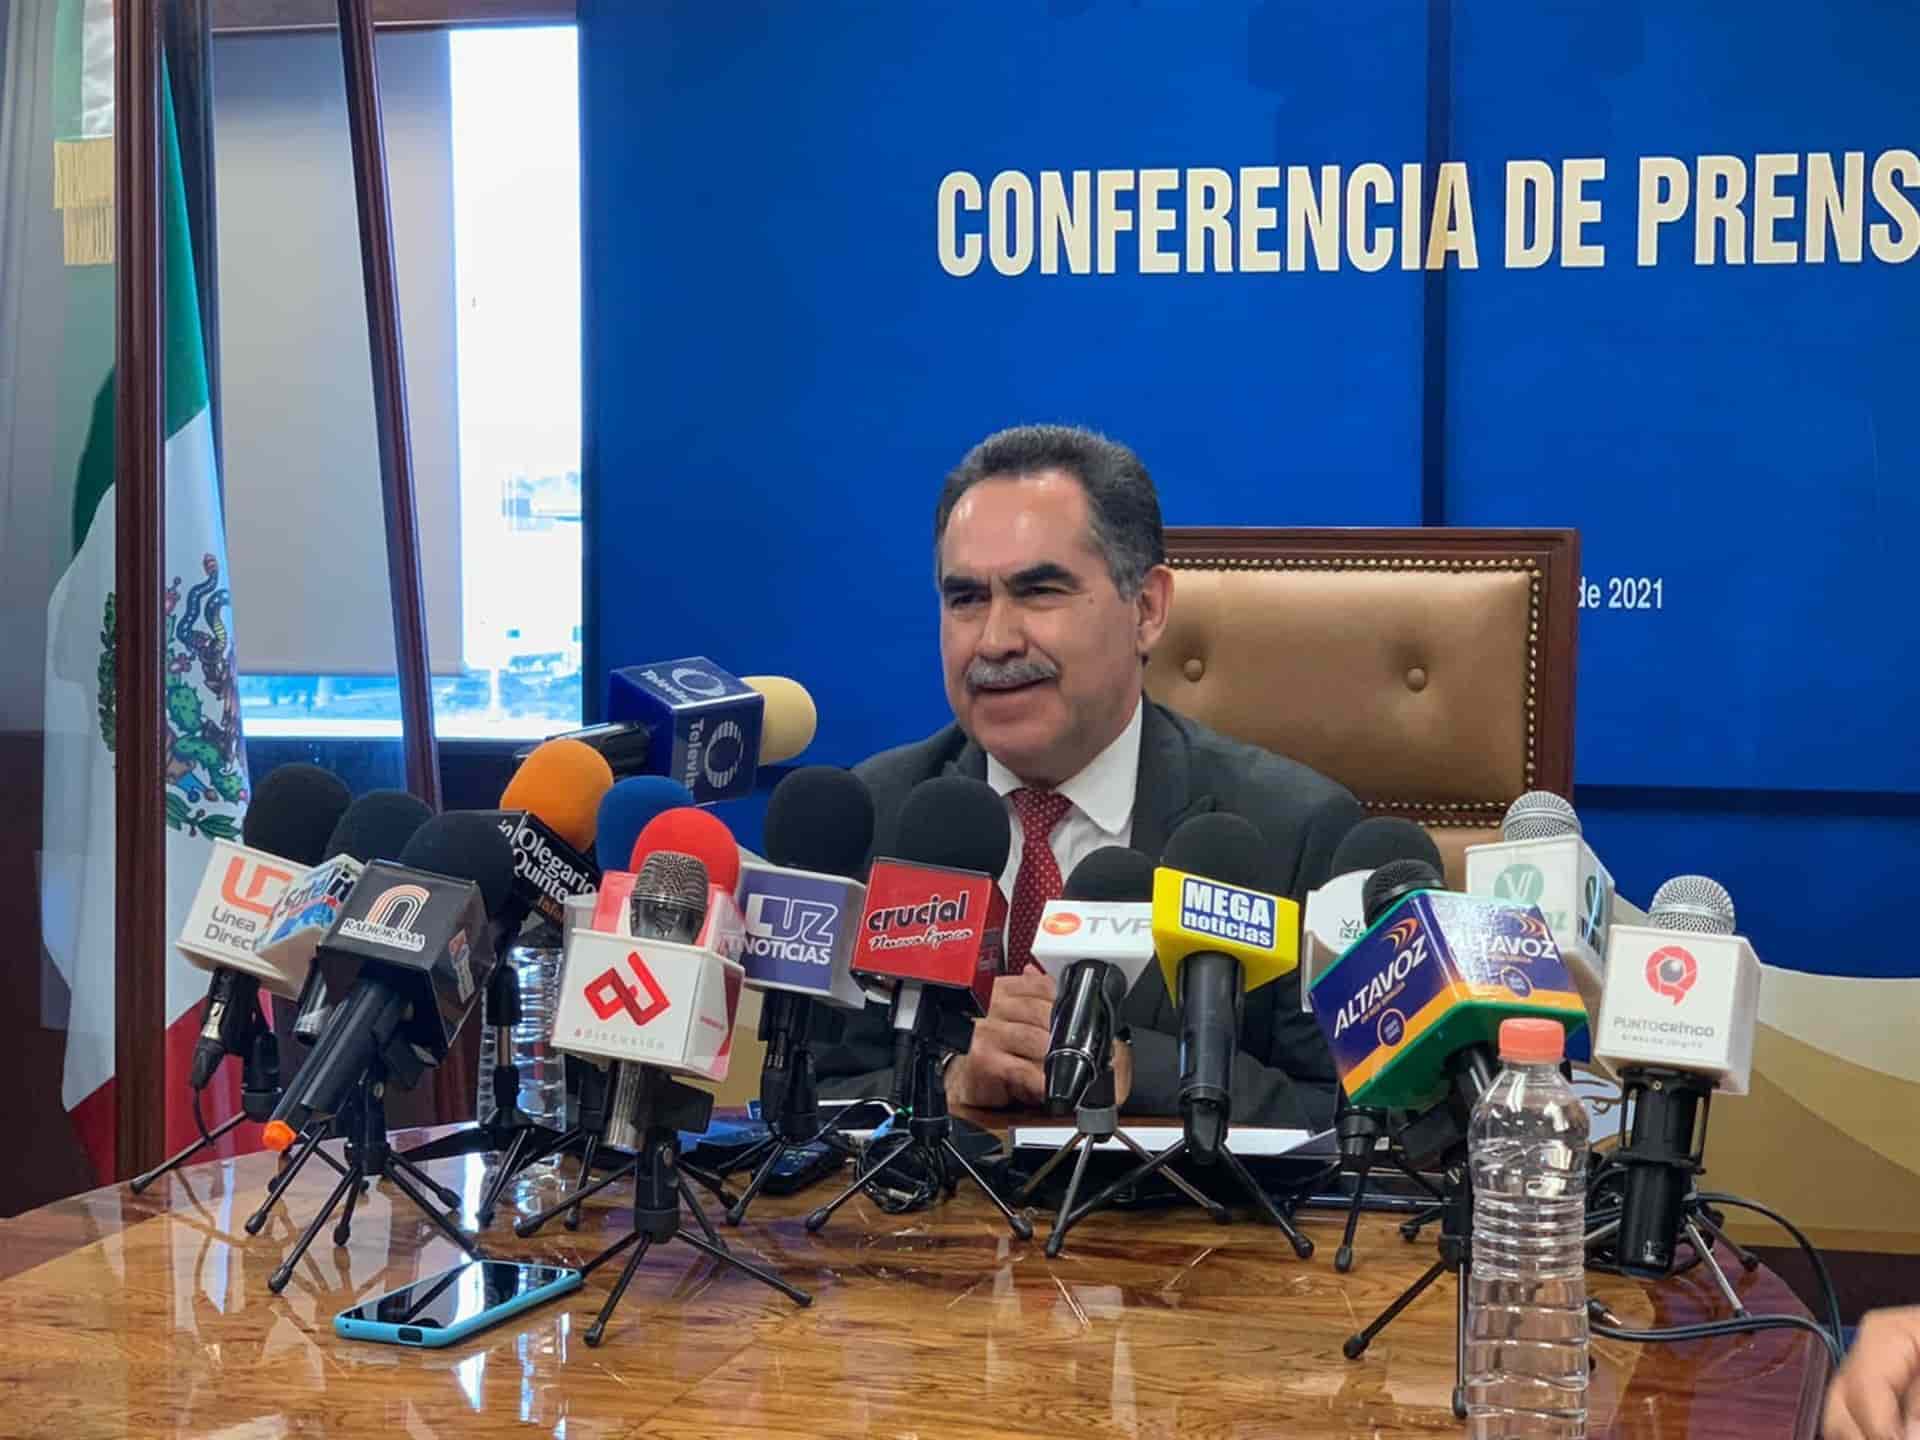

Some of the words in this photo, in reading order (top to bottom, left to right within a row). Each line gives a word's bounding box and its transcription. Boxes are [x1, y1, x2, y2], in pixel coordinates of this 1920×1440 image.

[937, 161, 1479, 276] CONFERENCIA
[1504, 158, 1606, 269] DE
[1608, 576, 1664, 609] 2021
[518, 827, 597, 895] Olegario
[867, 890, 970, 932] crucial
[1184, 880, 1271, 928] MEGA
[343, 917, 426, 946] RADIORAMA
[1183, 911, 1272, 947] noticias
[1333, 934, 1428, 1040] ALTAVOZ
